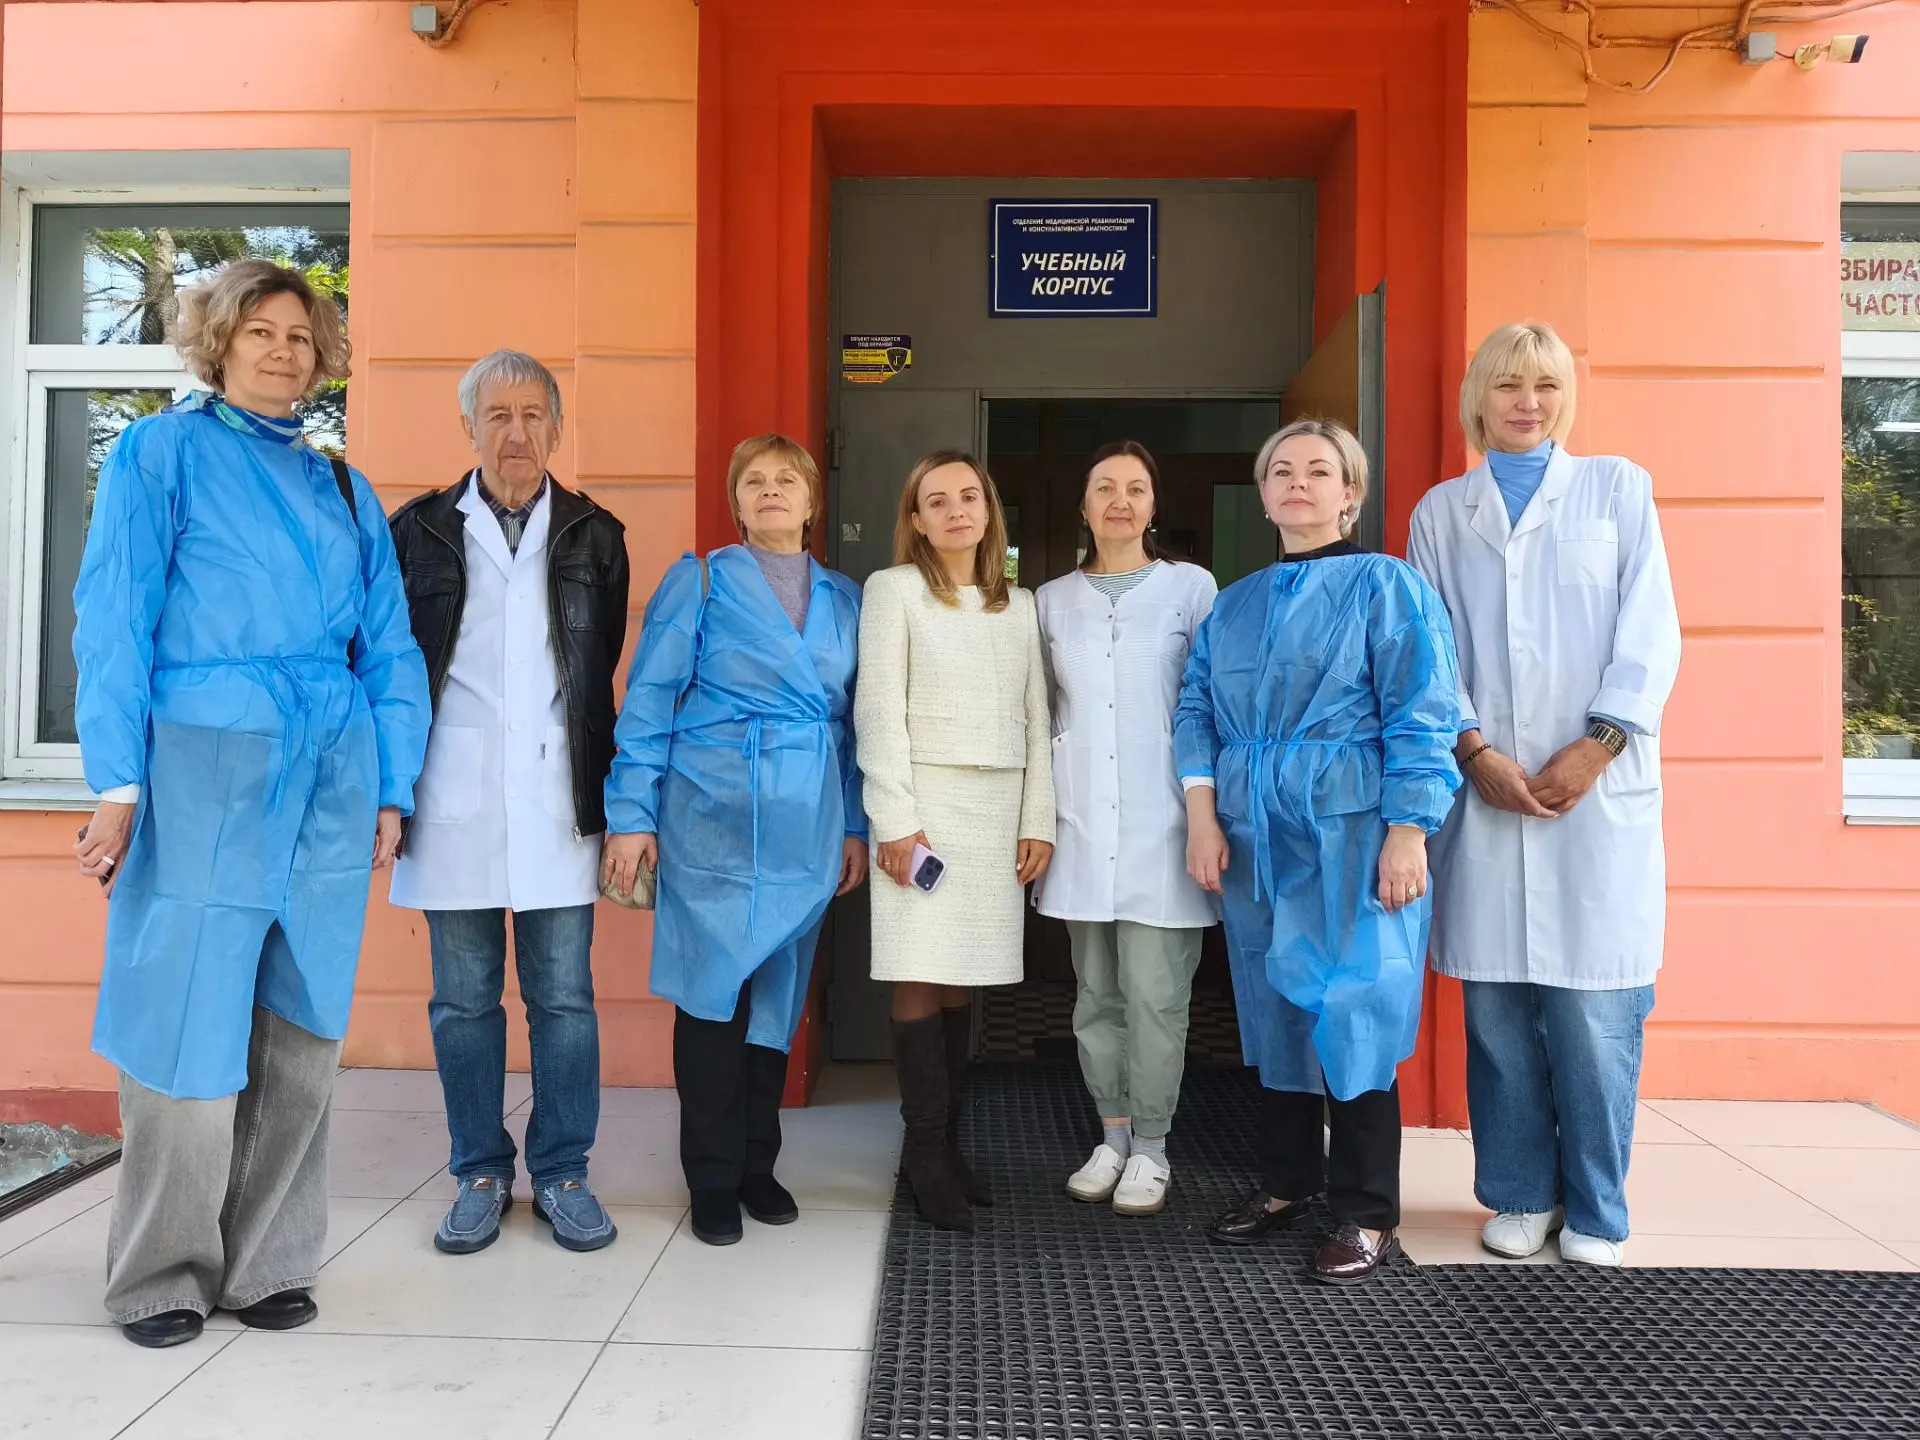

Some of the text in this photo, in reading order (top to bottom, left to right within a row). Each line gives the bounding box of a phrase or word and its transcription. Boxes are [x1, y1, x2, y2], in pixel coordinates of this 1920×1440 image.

[1012, 217, 1135, 226] ОТДЕЛЕНИЕ МЕДИЦИНСКОЙ РЕАБИЛИТАЦИИ
[1029, 225, 1084, 233] КОНСУЛЬТАТИВНОЙ
[1021, 249, 1127, 271] УЧЕБНЫЙ
[1840, 258, 1920, 282] ЗБИРА
[1031, 277, 1115, 295] КОРПУС
[1840, 293, 1920, 316] ЧАСТ
